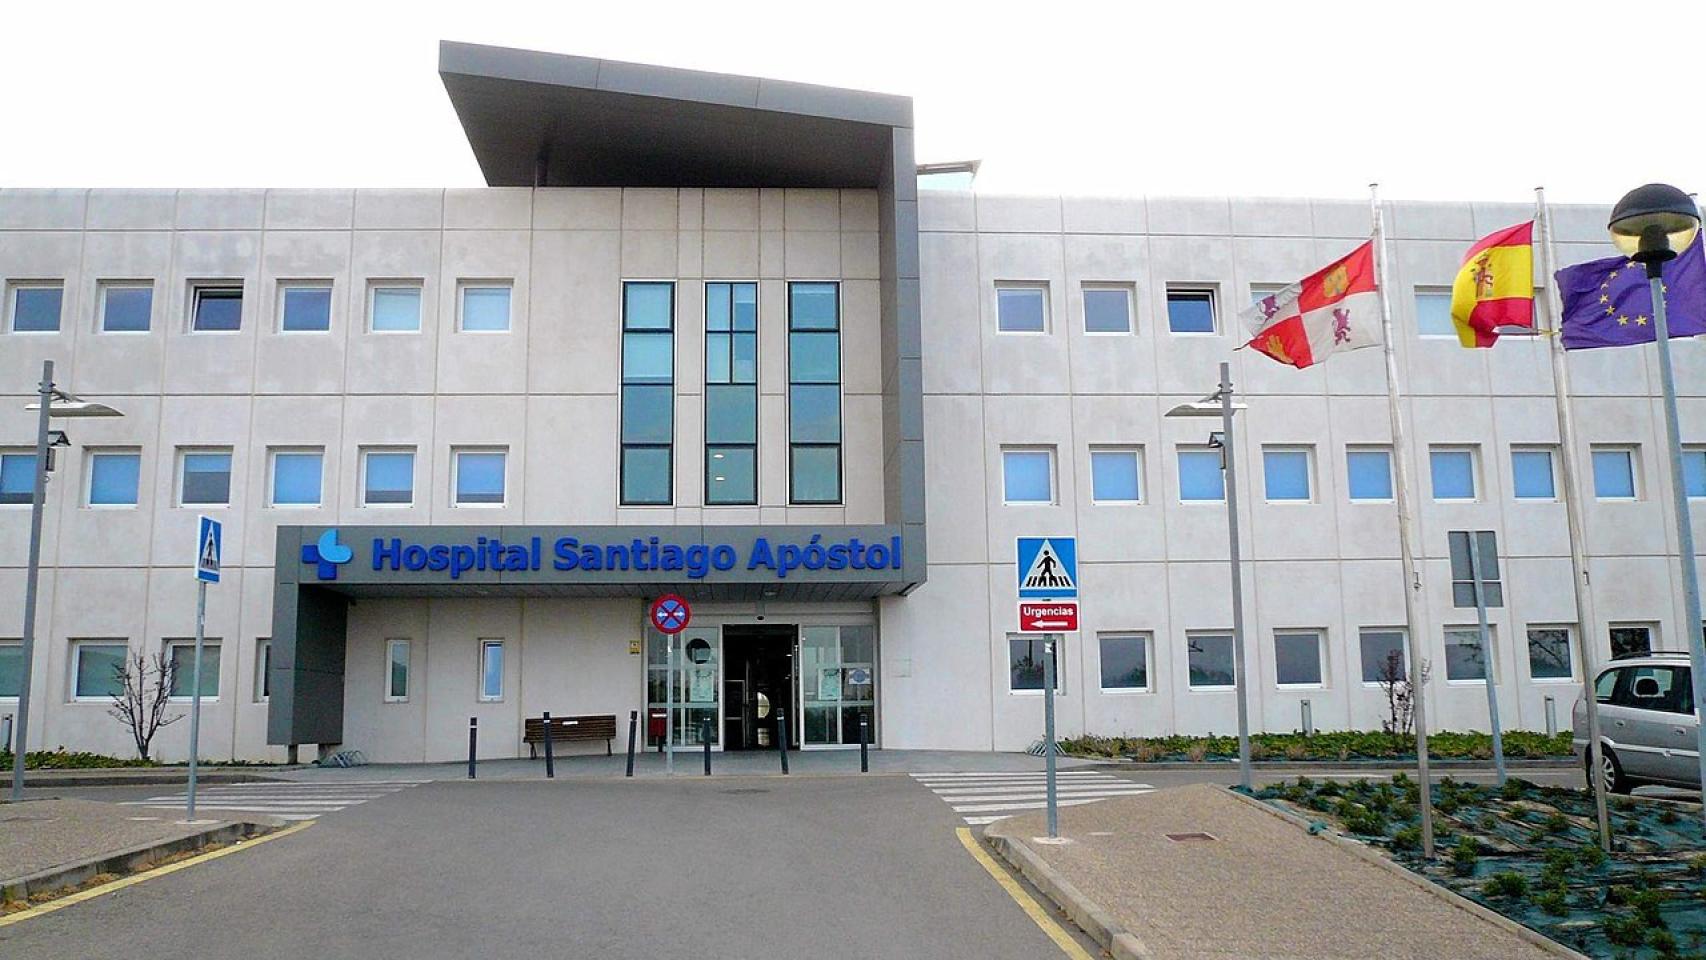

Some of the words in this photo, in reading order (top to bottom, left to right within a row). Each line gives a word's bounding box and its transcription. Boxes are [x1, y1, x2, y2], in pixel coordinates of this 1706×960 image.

[373, 537, 541, 579] Hospital
[553, 536, 737, 579] Santiago
[747, 534, 902, 577] Apóstol
[1023, 606, 1074, 617] Urgencias
